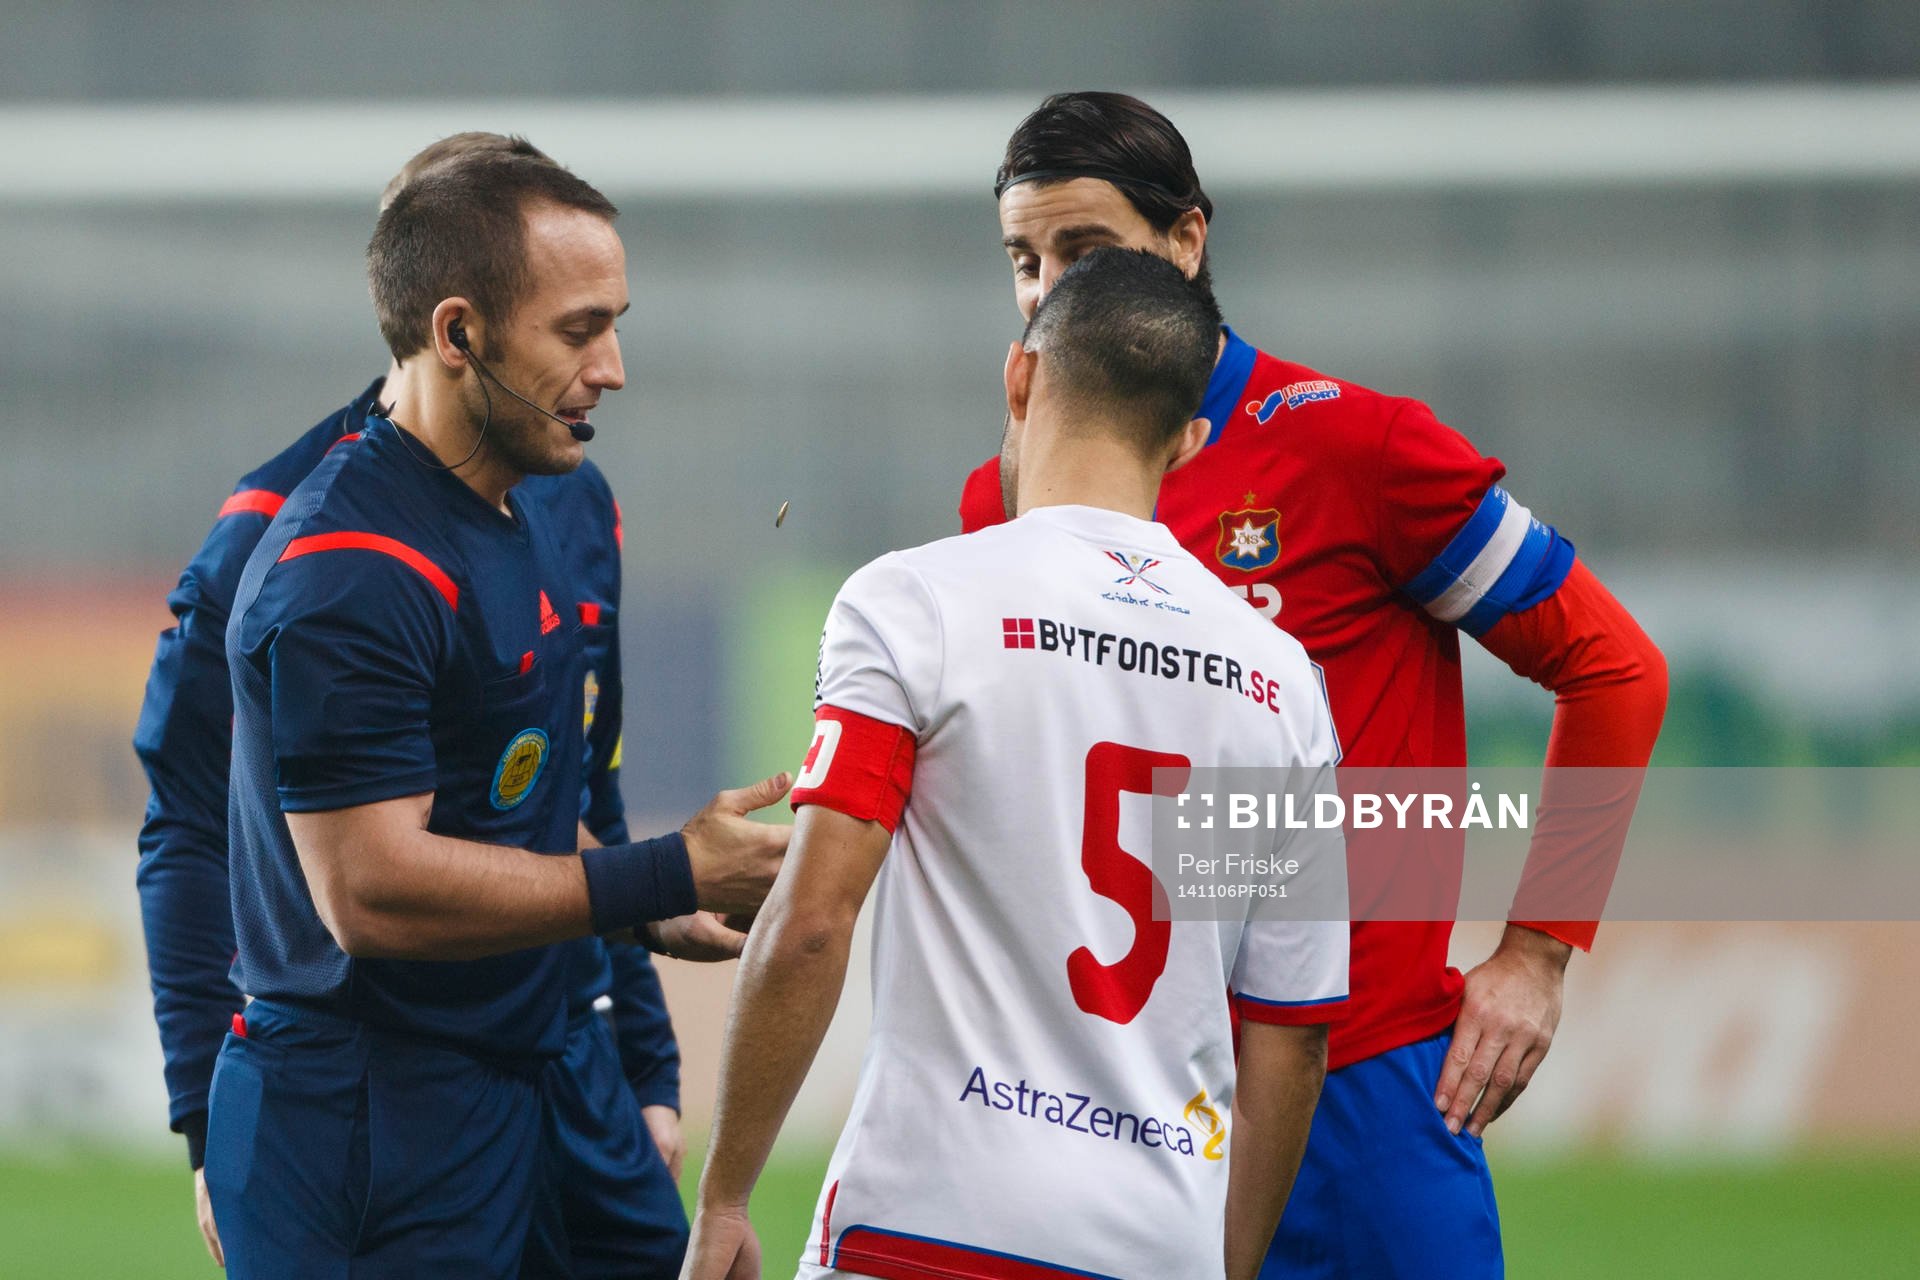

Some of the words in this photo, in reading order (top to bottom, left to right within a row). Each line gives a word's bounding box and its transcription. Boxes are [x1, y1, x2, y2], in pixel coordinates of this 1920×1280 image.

[1283, 380, 1341, 400] INTER
[1287, 388, 1341, 410] SPORT
[1066, 741, 1191, 1025] 5
[959, 1066, 1195, 1156] AstraZeneca
